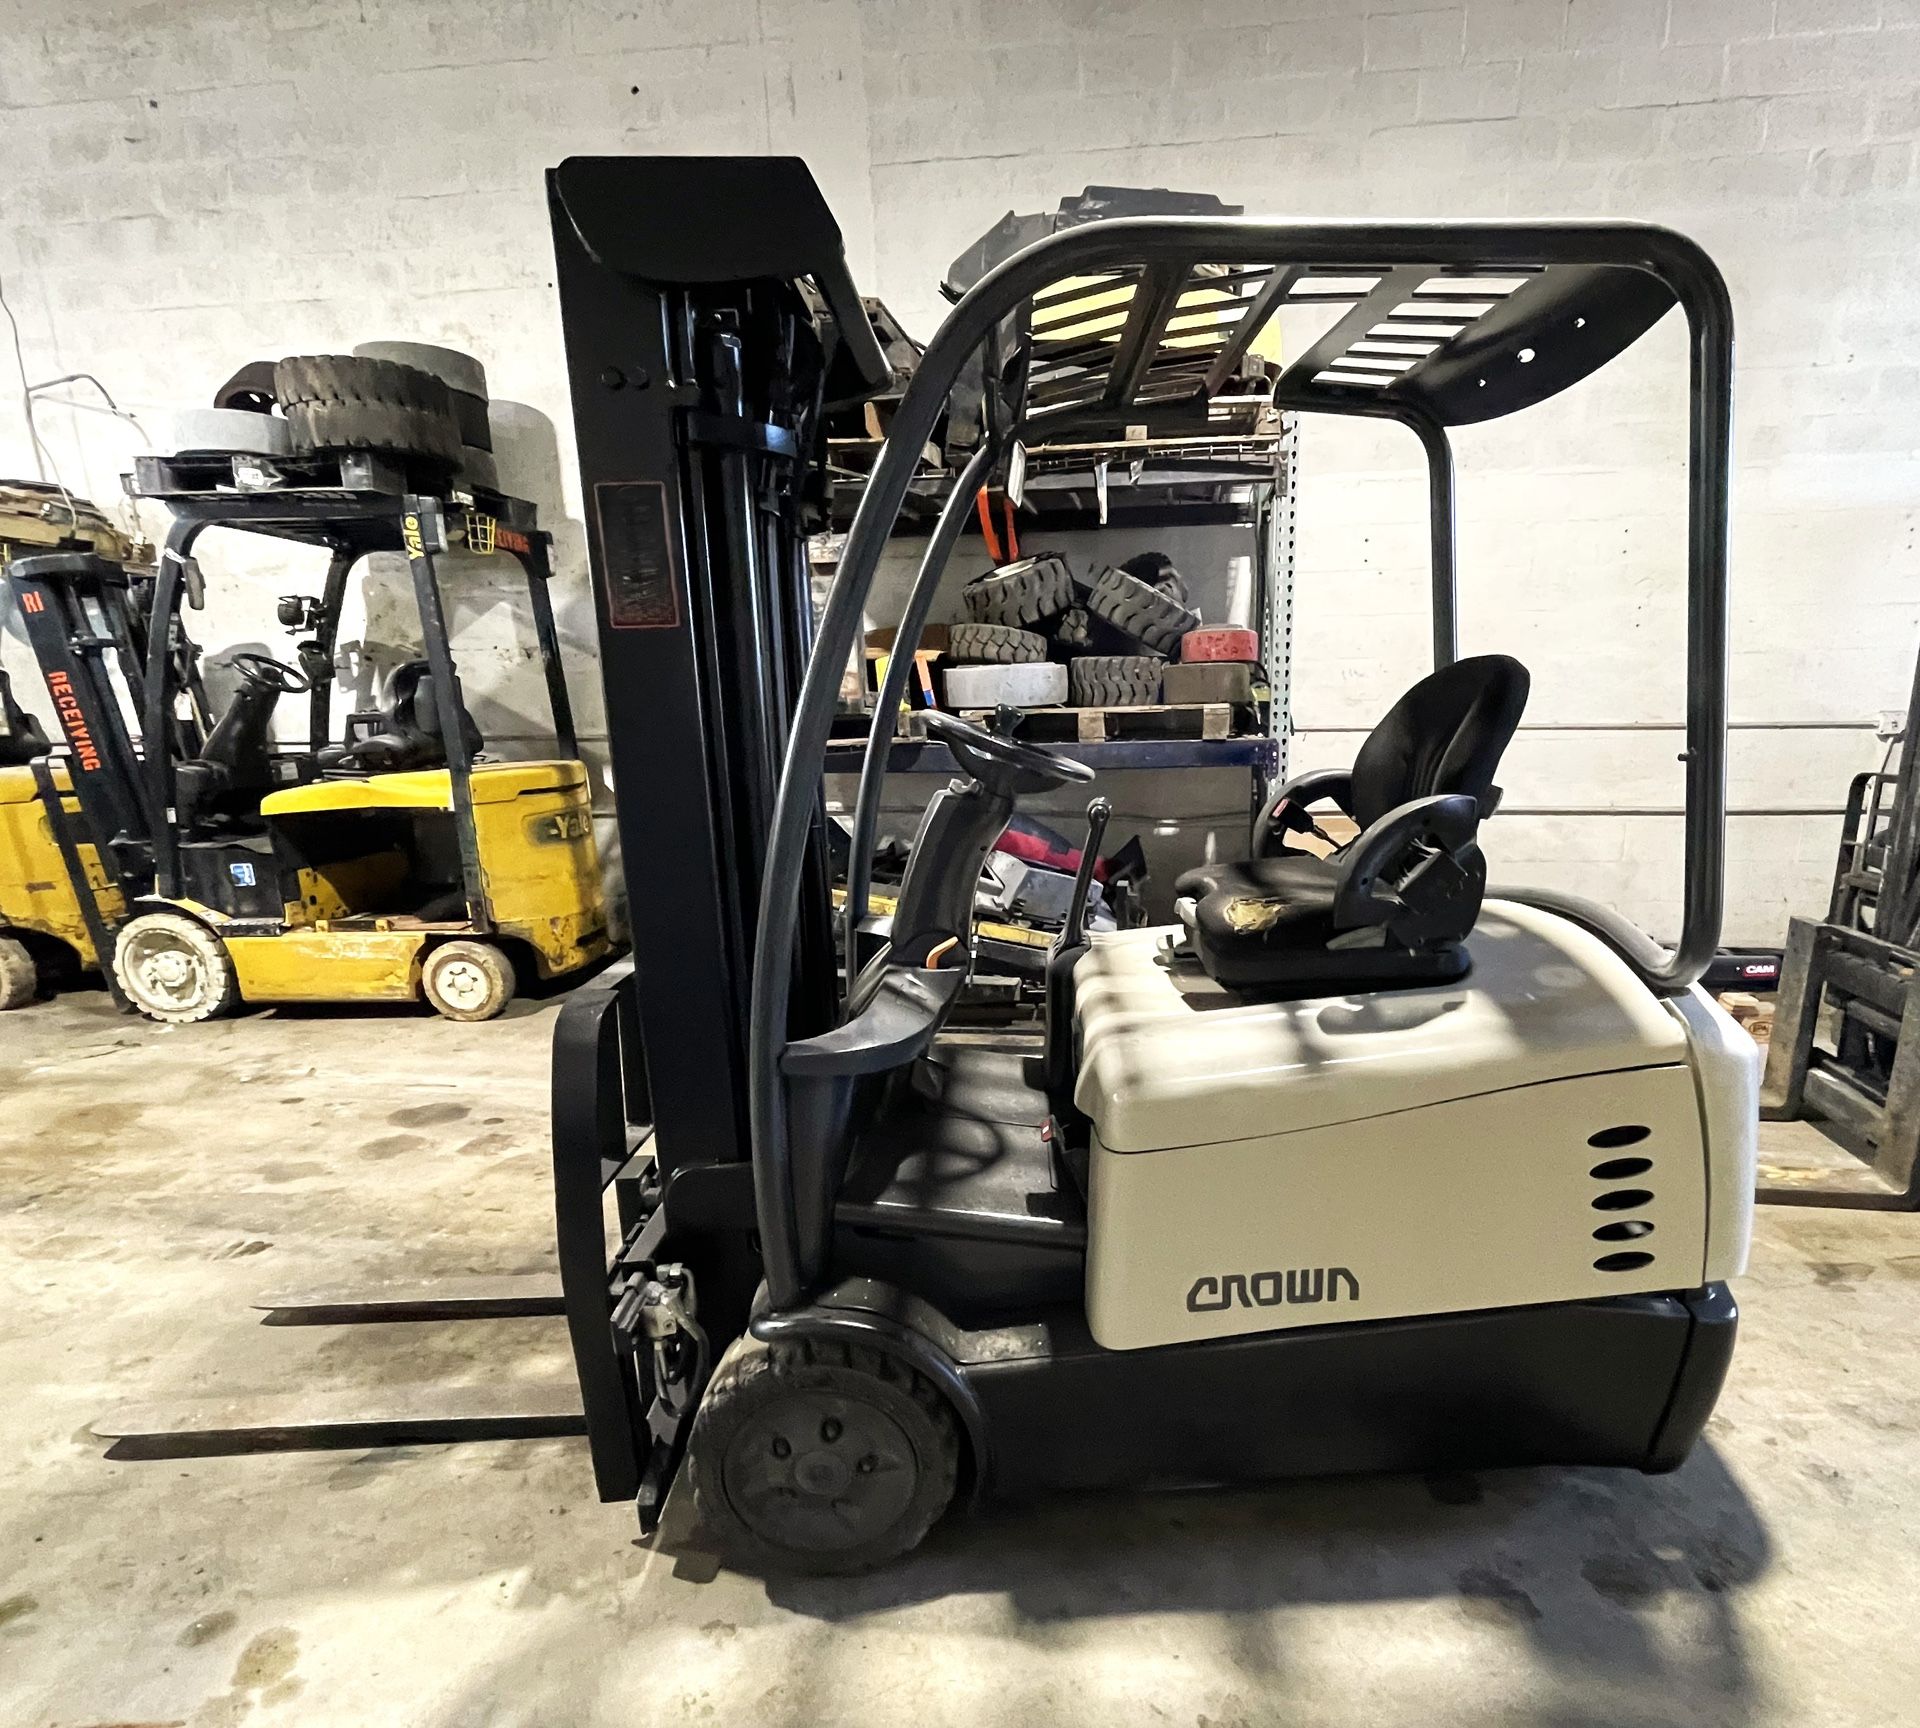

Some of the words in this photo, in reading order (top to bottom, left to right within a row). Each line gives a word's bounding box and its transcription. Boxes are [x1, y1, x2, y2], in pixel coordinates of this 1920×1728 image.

[403, 515, 425, 560] Yale
[48, 671, 101, 771] RECEIVING
[554, 813, 590, 839] Yale
[1745, 964, 1775, 974] CAM
[1187, 1267, 1359, 1312] CROWN
